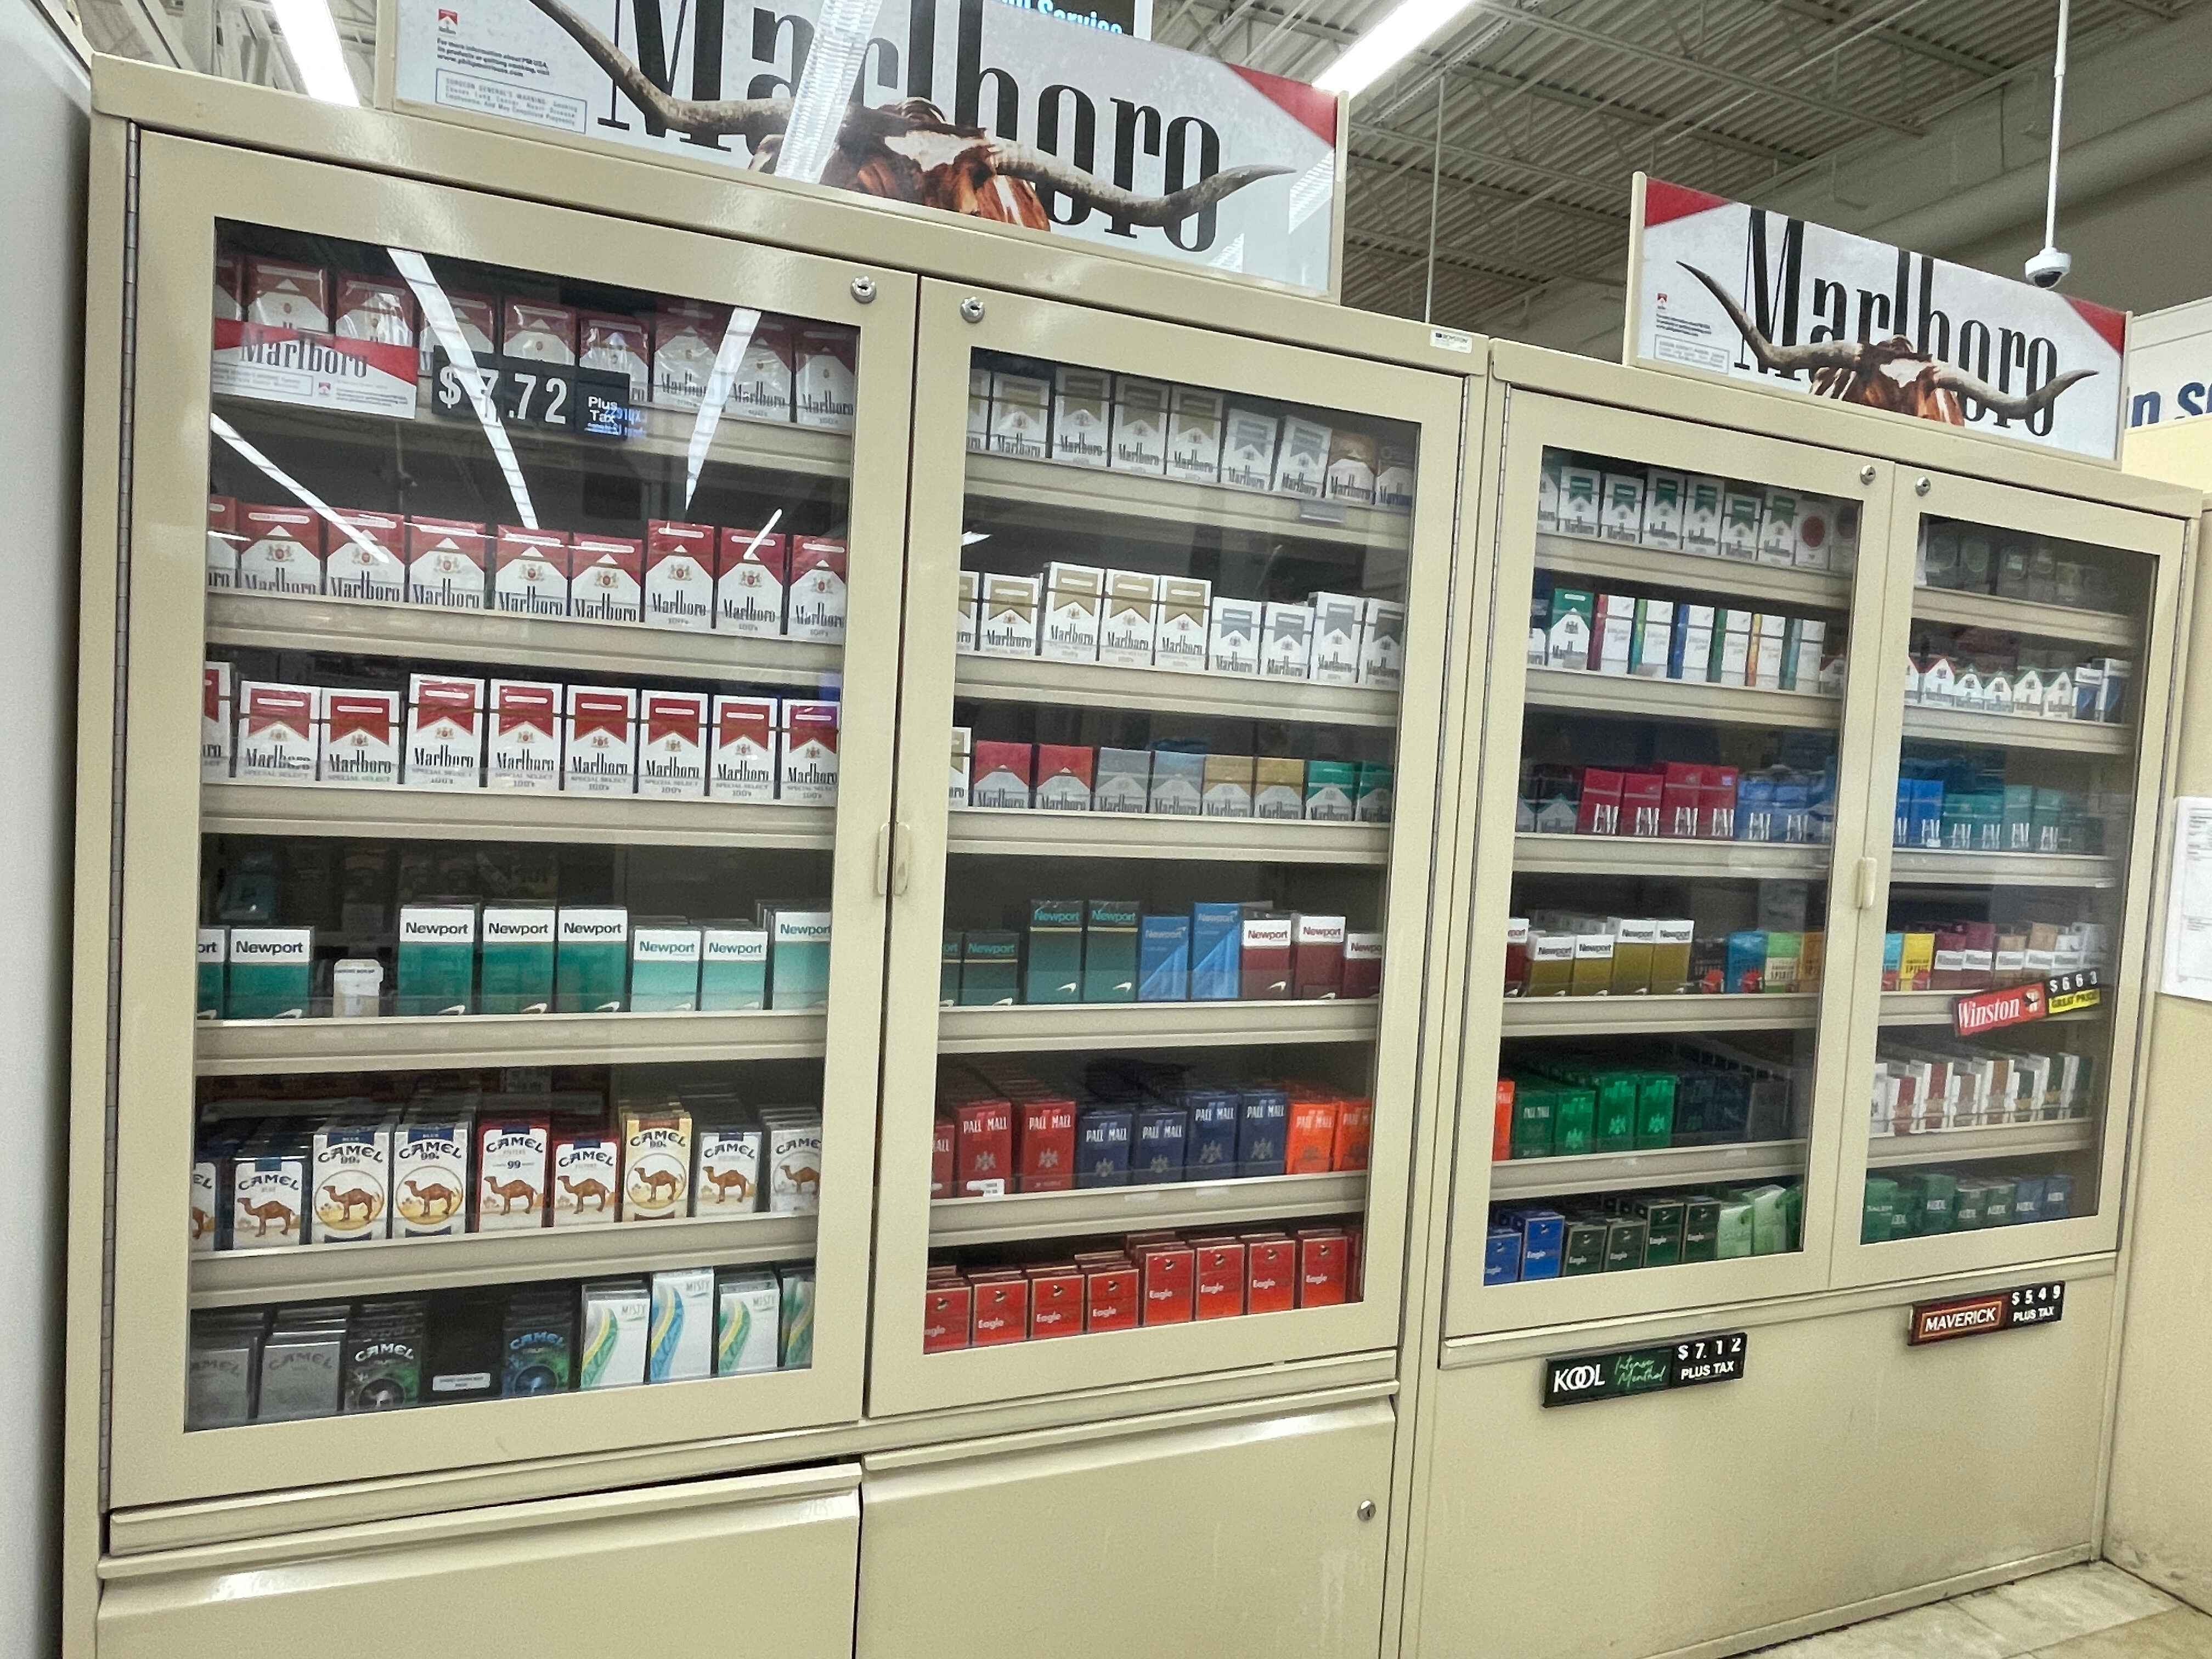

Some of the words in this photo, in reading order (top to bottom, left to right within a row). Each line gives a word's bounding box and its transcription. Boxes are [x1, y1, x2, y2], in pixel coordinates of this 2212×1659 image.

[1734, 206, 2057, 437] Marlboro
[588, 396, 618, 410] Plus
[245, 567, 317, 595] Marlboro
[330, 570, 400, 602] Marlboro
[413, 578, 480, 609] Marlboro
[498, 585, 563, 617] Marlboro
[574, 592, 637, 623] Marlboro
[652, 590, 707, 617] Marlboro
[724, 596, 776, 623] Marlboro
[795, 603, 845, 629] Marlboro
[987, 627, 1032, 648] Marlboro
[1050, 623, 1094, 645] Marlboro
[329, 749, 392, 774] Marlboro
[414, 744, 475, 769] Marlboro
[496, 748, 555, 772] Marlboro
[572, 752, 629, 775] Marlboro
[645, 757, 699, 778] Marlboro
[717, 760, 769, 782] Marlboro
[787, 763, 838, 785] Marlboro
[1034, 909, 1081, 922] Newport
[1091, 909, 1137, 922] Newport
[405, 921, 469, 936] Newport
[488, 922, 549, 936] Newport
[563, 922, 623, 935] Newport
[780, 923, 830, 935] Newpor
[1248, 929, 1288, 940] Newport
[1302, 926, 1341, 936] Newport
[235, 940, 303, 955] Newport
[639, 941, 696, 955] Newport
[708, 943, 763, 955] Newport
[1958, 998, 2020, 1029] Winston
[1194, 1108, 1213, 1122] PALL
[1216, 1106, 1235, 1120] MALL
[1246, 1104, 1263, 1119] PALL
[1267, 1104, 1285, 1118] MALL
[963, 1120, 983, 1134] PALL
[987, 1116, 1008, 1131] MALL
[1029, 1115, 1047, 1130] PALL
[1051, 1114, 1072, 1129] MALL
[630, 1130, 686, 1148] CAMEL
[1086, 1128, 1105, 1143] PALL
[1108, 1127, 1127, 1142] MALL
[1142, 1125, 1160, 1139] PALL
[1163, 1124, 1183, 1138] MALL
[319, 1144, 383, 1164] CAMEL
[398, 1139, 462, 1159] CAMEL
[486, 1136, 544, 1154] CAMEL
[704, 1141, 755, 1159] CAMEL
[776, 1138, 821, 1155] CAME
[558, 1150, 614, 1167] CAMEL
[238, 1174, 300, 1191] CAMEL
[685, 1279, 710, 1291] MISTY
[1149, 1288, 1173, 1300] Eagle
[1200, 1282, 1224, 1295] Eagle
[621, 1303, 646, 1316] MISTY
[752, 1295, 777, 1308] MISTY
[1036, 1311, 1062, 1324] Eagle
[1092, 1306, 1118, 1318] Eagle
[1925, 1307, 1997, 1332] MAVERICK
[2013, 1309, 2037, 1322] PLUS
[2038, 1306, 2055, 1318] TAX
[923, 1325, 946, 1338] agle
[978, 1317, 1005, 1330] Eagle
[509, 1331, 565, 1351] CAMEL
[1678, 1337, 1742, 1361] $7.12
[354, 1342, 415, 1363] CAMEL
[1553, 1364, 1605, 1393] KOOL
[1681, 1364, 1711, 1381] PLUS
[1712, 1361, 1735, 1375] TAX
